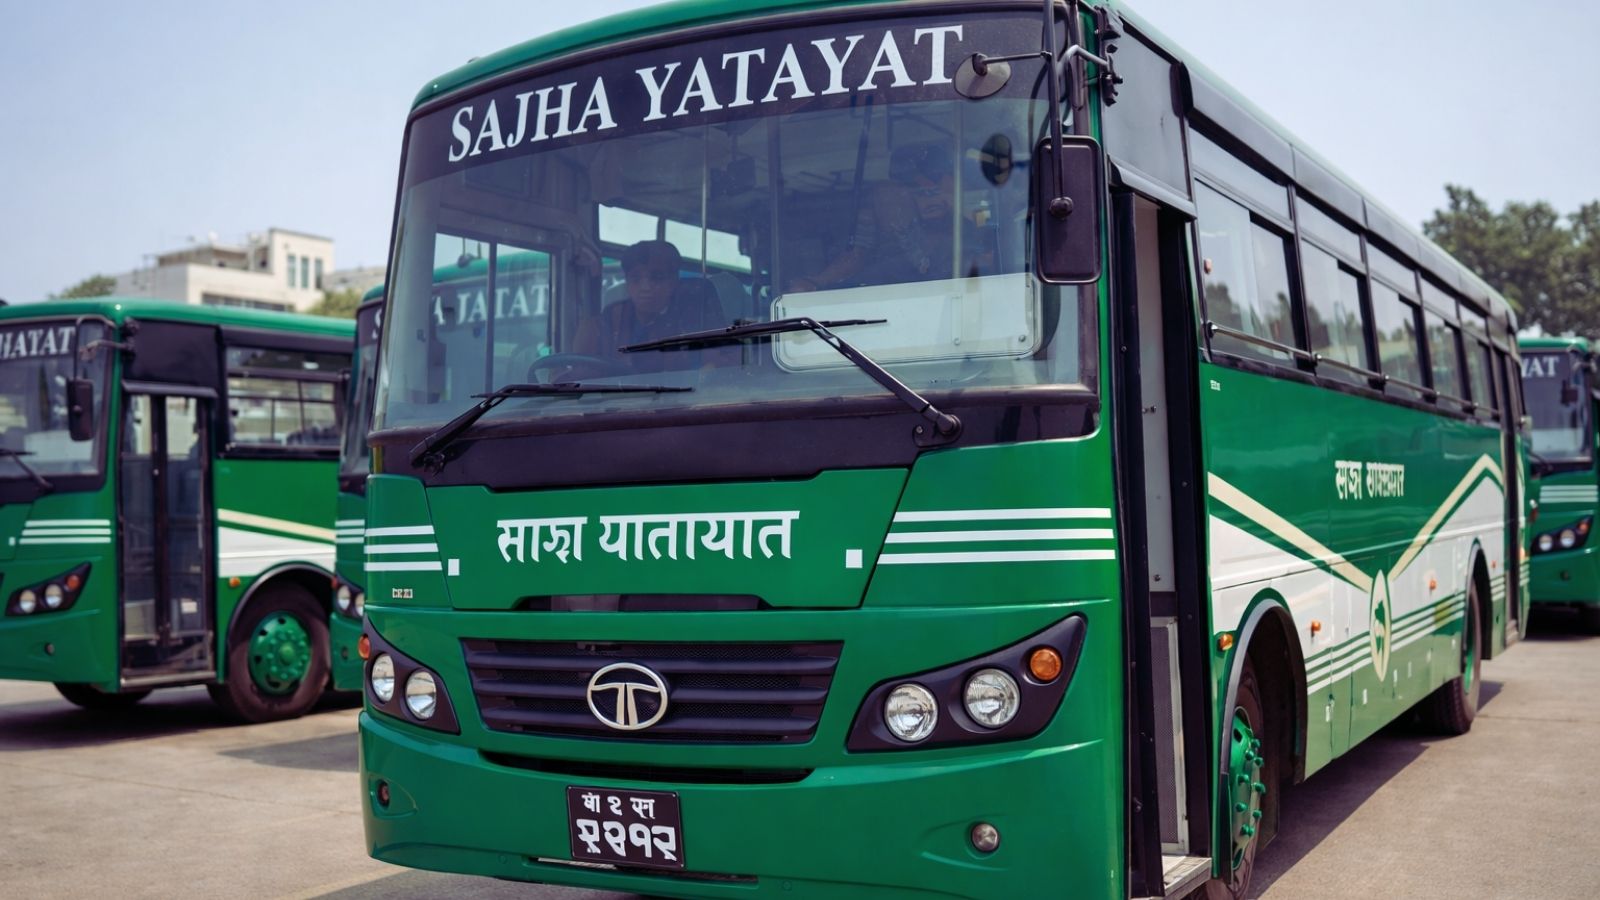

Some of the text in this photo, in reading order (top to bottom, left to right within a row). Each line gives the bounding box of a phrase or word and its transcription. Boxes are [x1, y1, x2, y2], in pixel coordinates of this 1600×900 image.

[448, 24, 964, 163] SAJHA YATAYAT
[599, 510, 800, 561] यातायात
